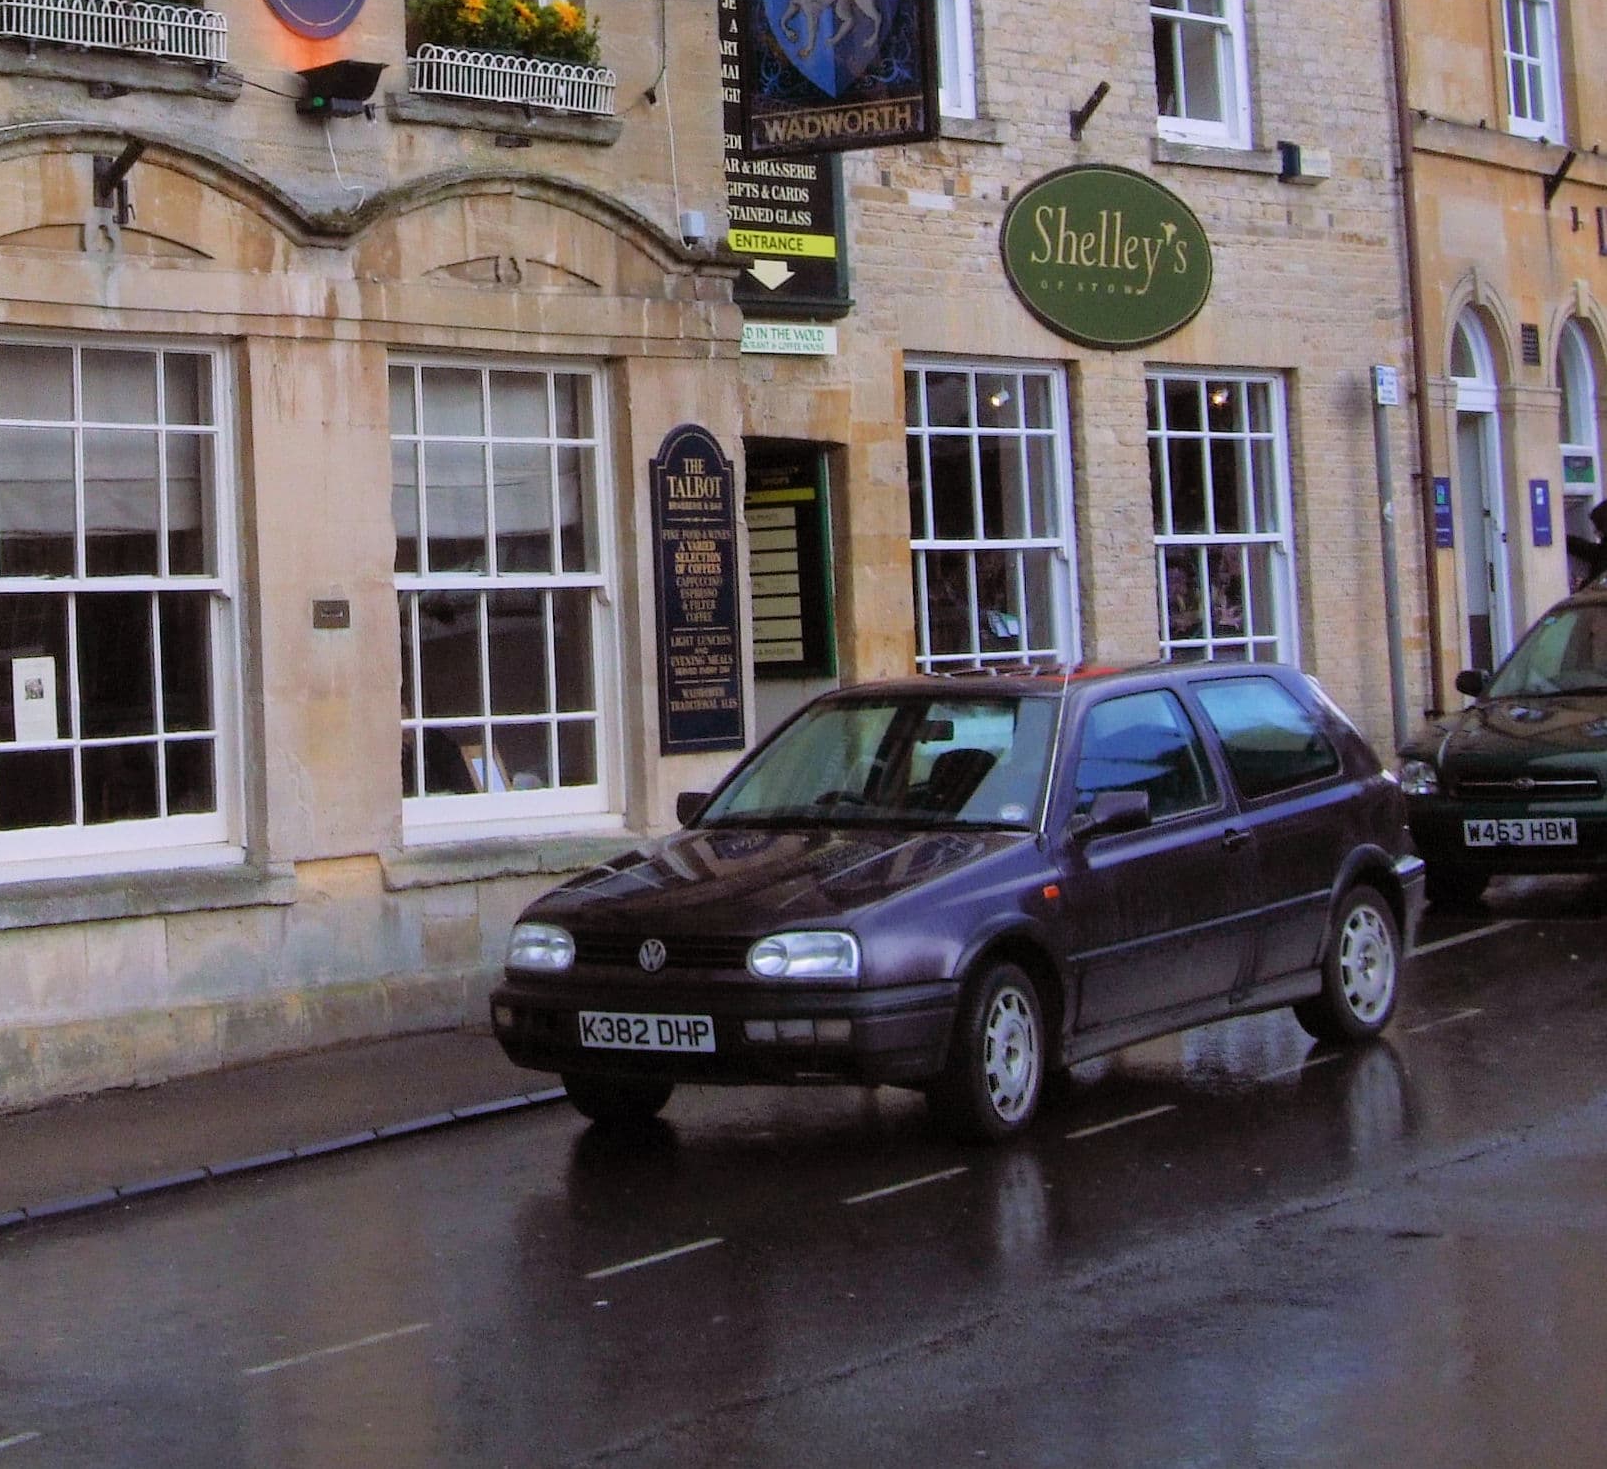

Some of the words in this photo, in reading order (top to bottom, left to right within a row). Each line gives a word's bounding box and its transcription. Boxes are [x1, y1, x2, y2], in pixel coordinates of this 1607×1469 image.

[764, 103, 912, 143] WADWORTH
[724, 158, 740, 173] AR
[752, 161, 817, 180] BRASSERIE
[727, 181, 759, 198] GIFTS
[761, 185, 770, 199] &
[772, 185, 810, 203] CARDS
[727, 205, 773, 223] STAINED
[776, 209, 812, 226] GLASS
[735, 233, 804, 251] ENTRANCE
[1031, 205, 1188, 295] Shelley's
[771, 328, 790, 340] THE
[793, 329, 824, 341] WOLD
[683, 457, 706, 475] THE
[666, 475, 723, 499] TALBOT
[1467, 822, 1524, 842] W463
[1531, 821, 1573, 841] HBW
[582, 1016, 650, 1045] K382
[657, 1019, 709, 1046] DHP
